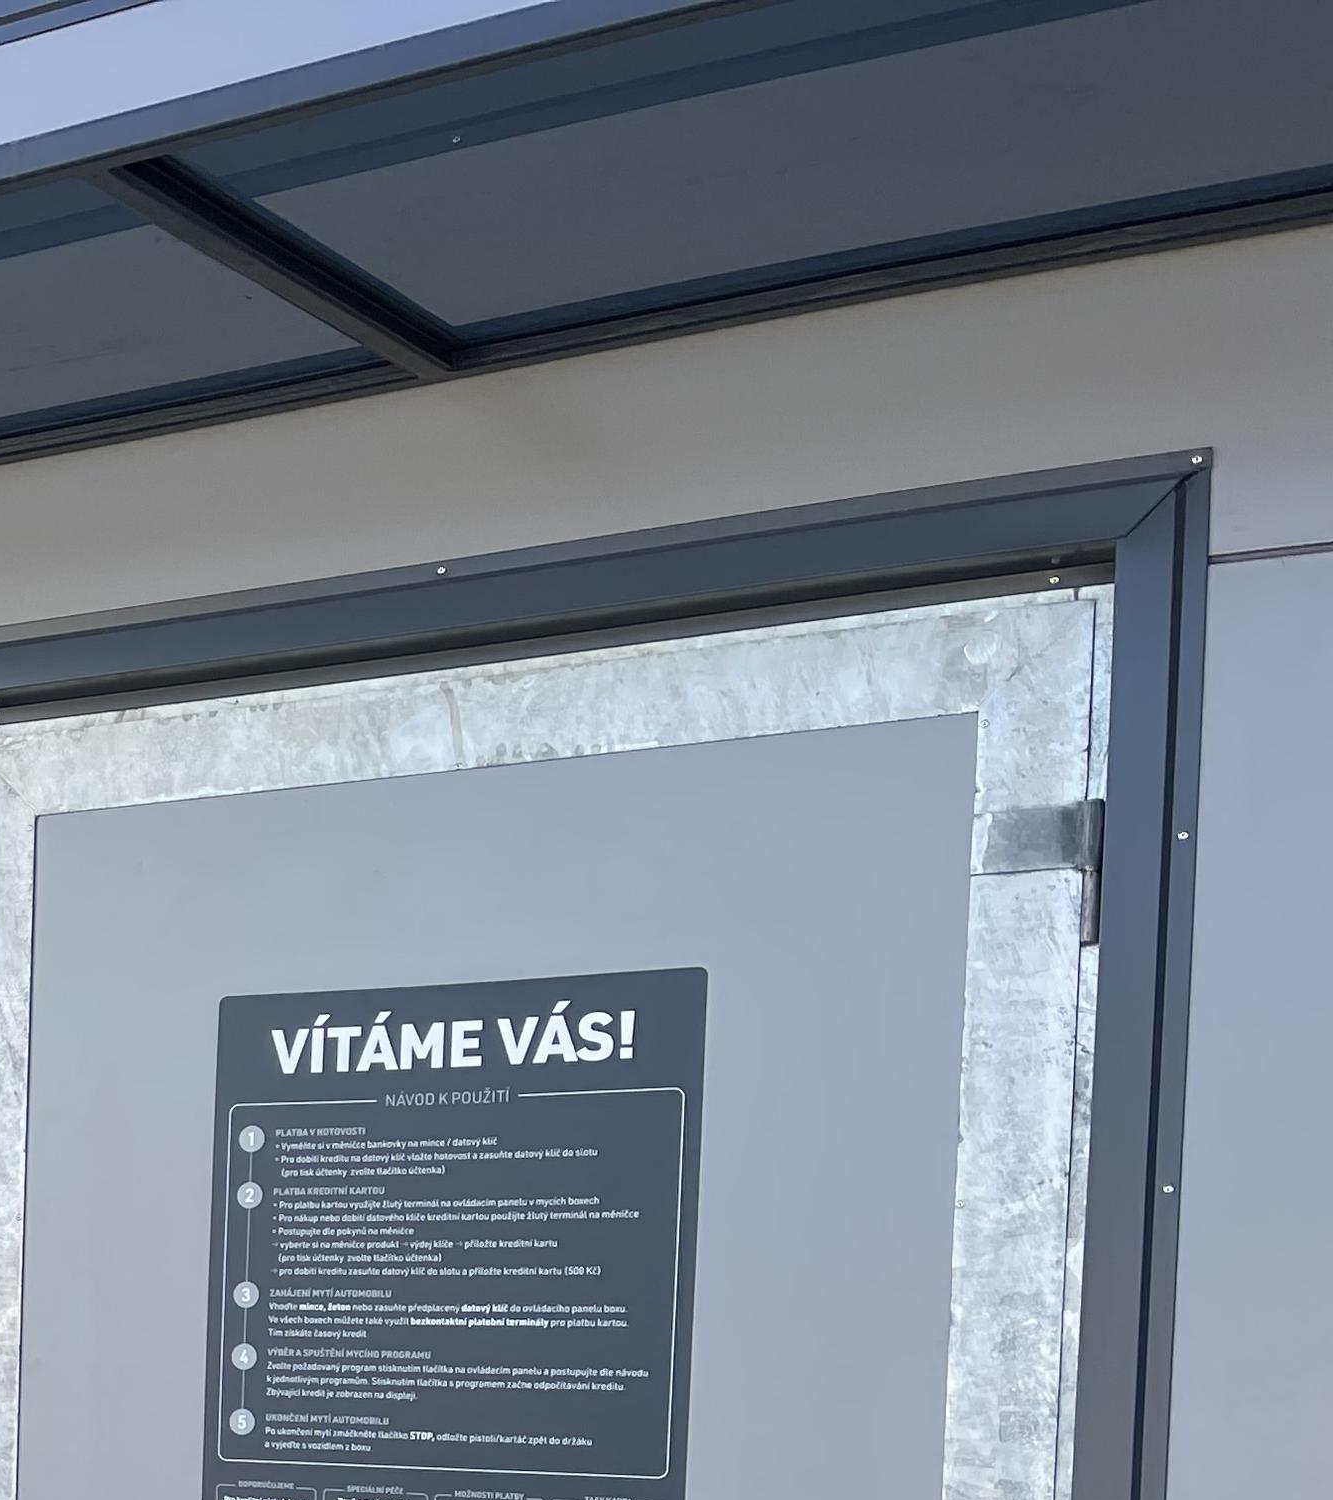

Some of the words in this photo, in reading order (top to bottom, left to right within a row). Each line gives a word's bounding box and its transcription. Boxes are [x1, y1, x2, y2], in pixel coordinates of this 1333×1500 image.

[272, 1010, 483, 1075] VÍTÁME
[497, 999, 637, 1066] VÁS!
[385, 1091, 436, 1107] NÁVOD
[438, 1092, 449, 1106] K
[451, 1087, 511, 1105] POUŽITÍ
[248, 1132, 254, 1146] 1
[276, 1129, 308, 1137] PLATBA
[309, 1128, 315, 1136] V
[317, 1127, 366, 1136] HOTOVOSTI
[245, 1189, 254, 1202] 2
[273, 1187, 306, 1196] PLATBA
[307, 1186, 347, 1195] KREDITNÍ
[349, 1187, 385, 1195] KARTOU
[241, 1288, 250, 1302] 3
[269, 1288, 311, 1298] ZAHÁJENÍ
[312, 1288, 333, 1298] MYTÍ
[335, 1289, 392, 1298] AUTOMOBILU
[240, 1350, 249, 1364] 4
[237, 1415, 246, 1430] 5
[265, 1413, 309, 1423] UKONČENÍ
[310, 1414, 332, 1424] MYTÍ
[333, 1416, 389, 1425] AUTOMOBILU
